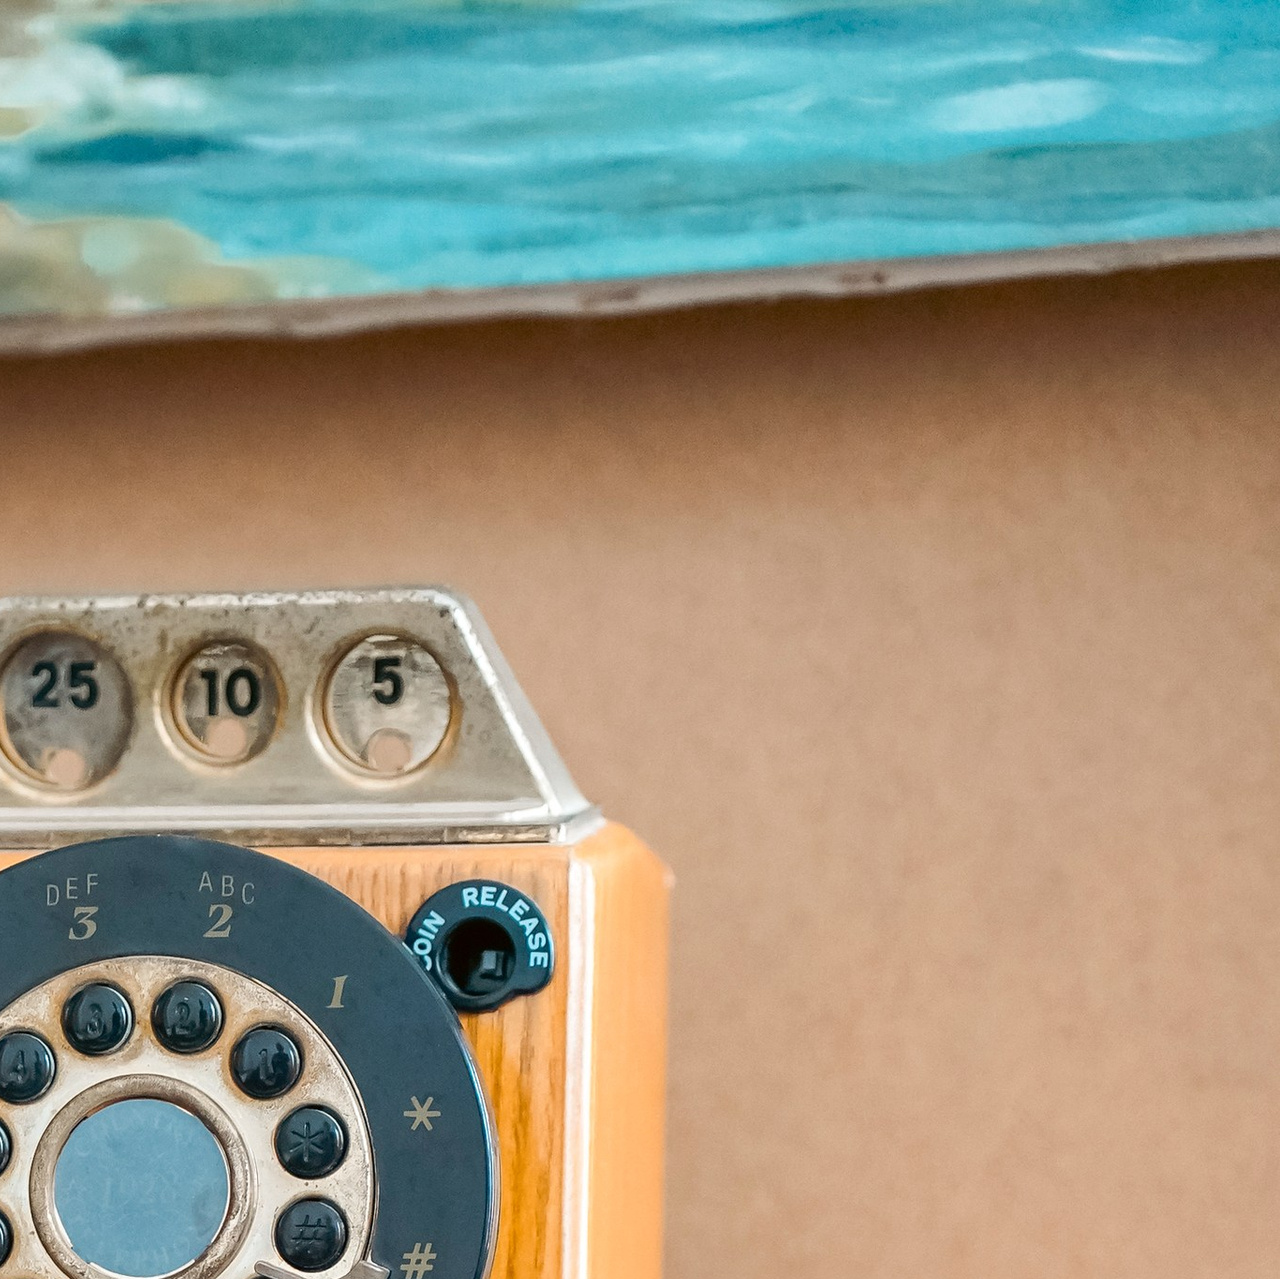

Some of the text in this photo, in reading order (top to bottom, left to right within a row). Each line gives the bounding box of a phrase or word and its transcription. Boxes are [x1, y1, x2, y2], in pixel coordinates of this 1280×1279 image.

[31, 656, 404, 718] 25 10 5
[46, 873, 100, 907] DEF
[198, 871, 255, 905] ABC
[68, 906, 99, 940] 3
[203, 903, 234, 938] 2
[461, 886, 549, 969] RELEASE
[326, 974, 349, 1009] 1
